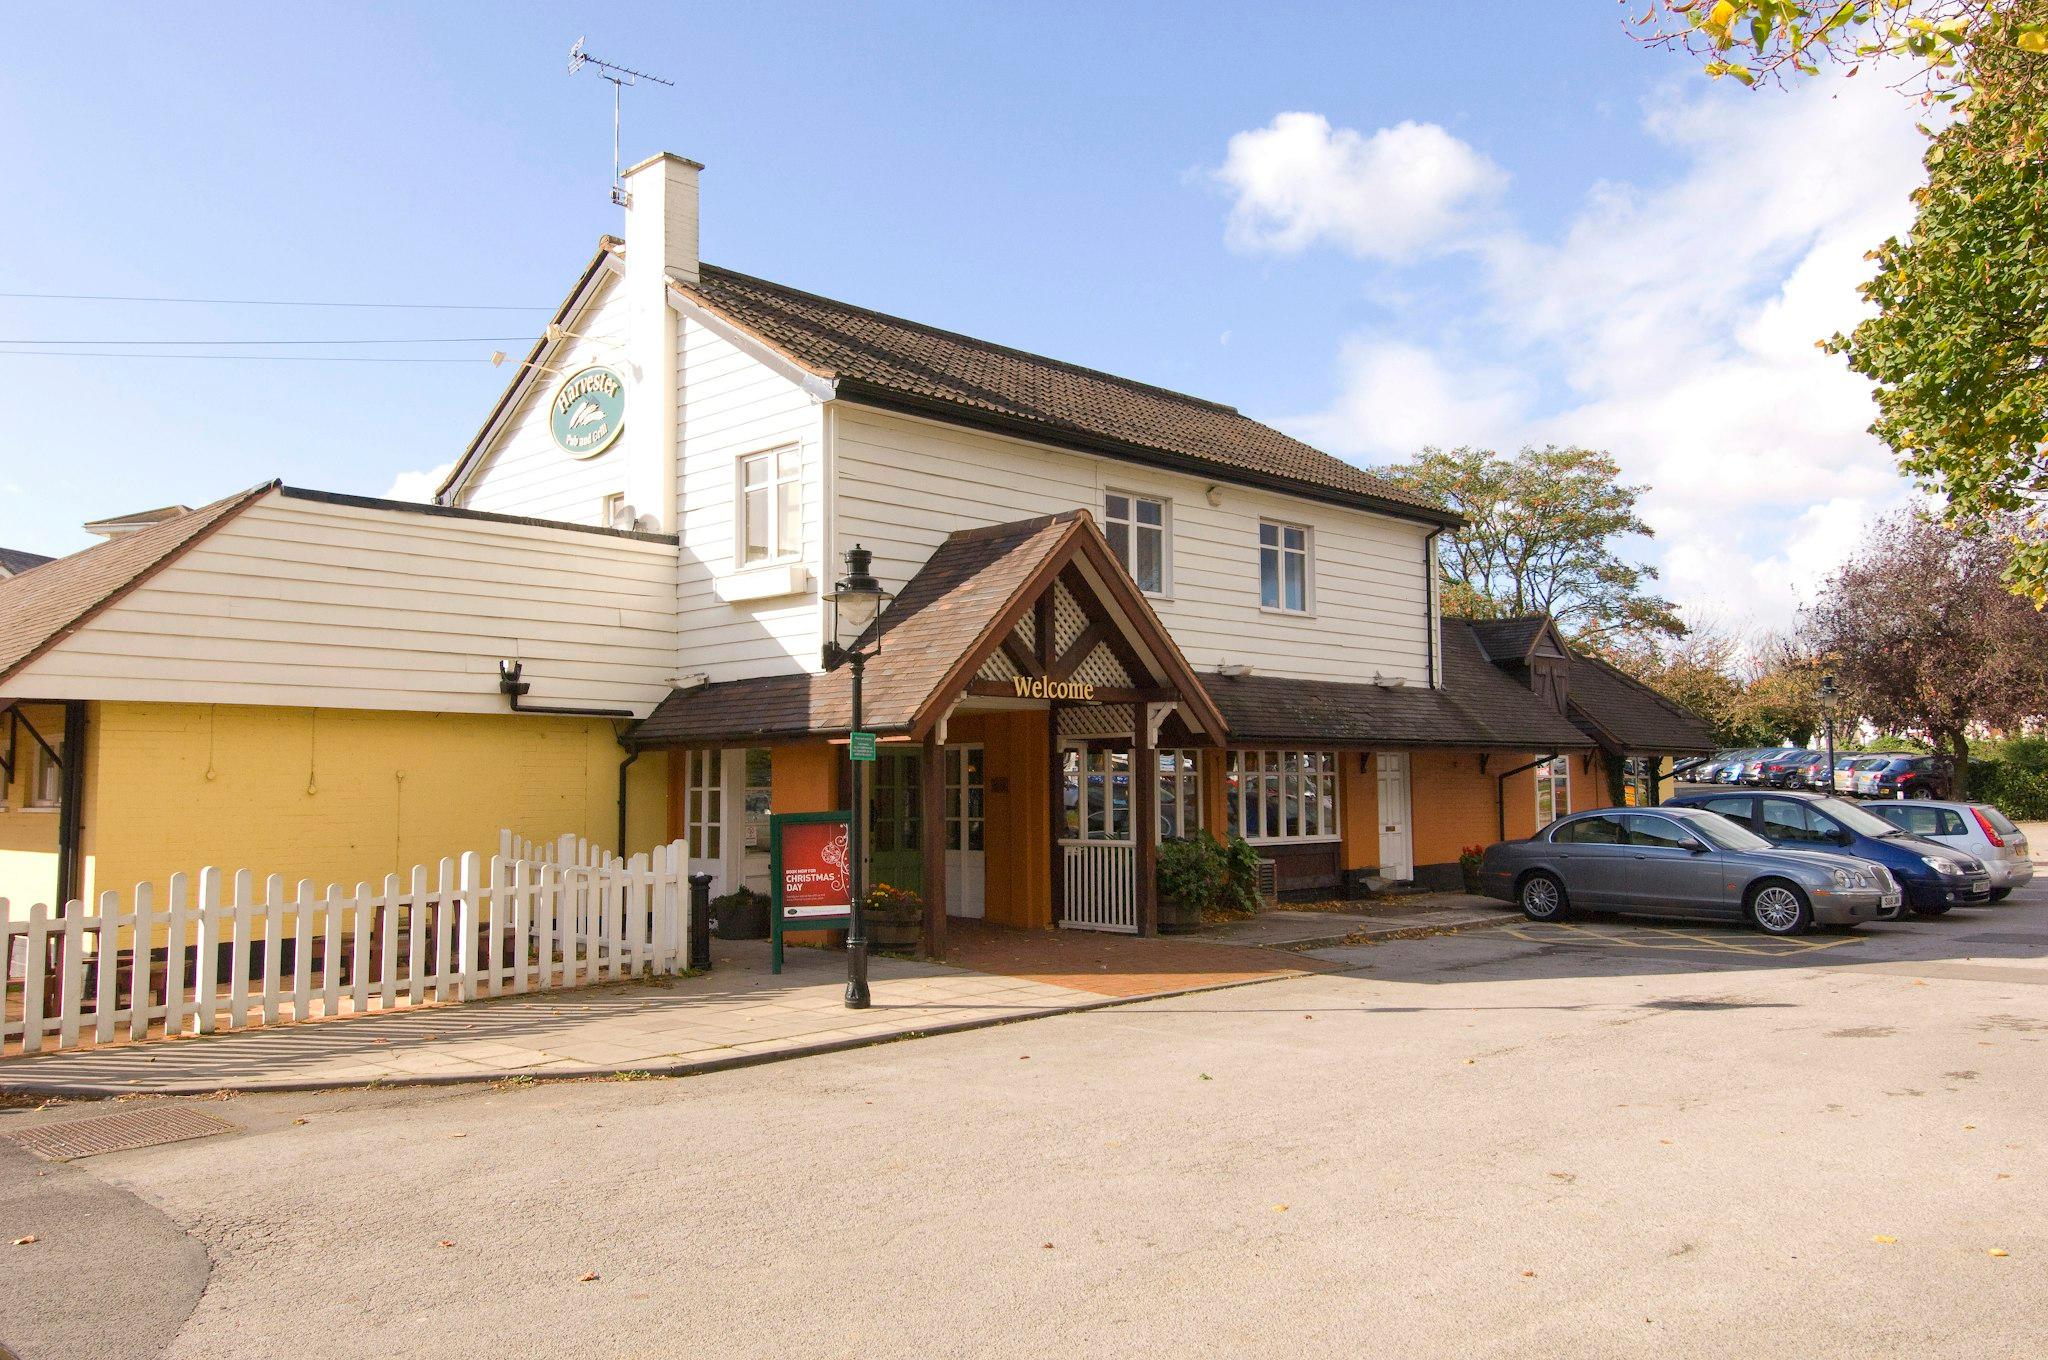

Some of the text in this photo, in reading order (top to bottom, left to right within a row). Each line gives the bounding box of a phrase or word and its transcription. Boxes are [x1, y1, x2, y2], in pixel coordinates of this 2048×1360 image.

[558, 374, 620, 414] Harvester
[1012, 675, 1094, 700] Welcome
[786, 873, 834, 882] CHRISTMAS
[787, 883, 802, 891] DAY
